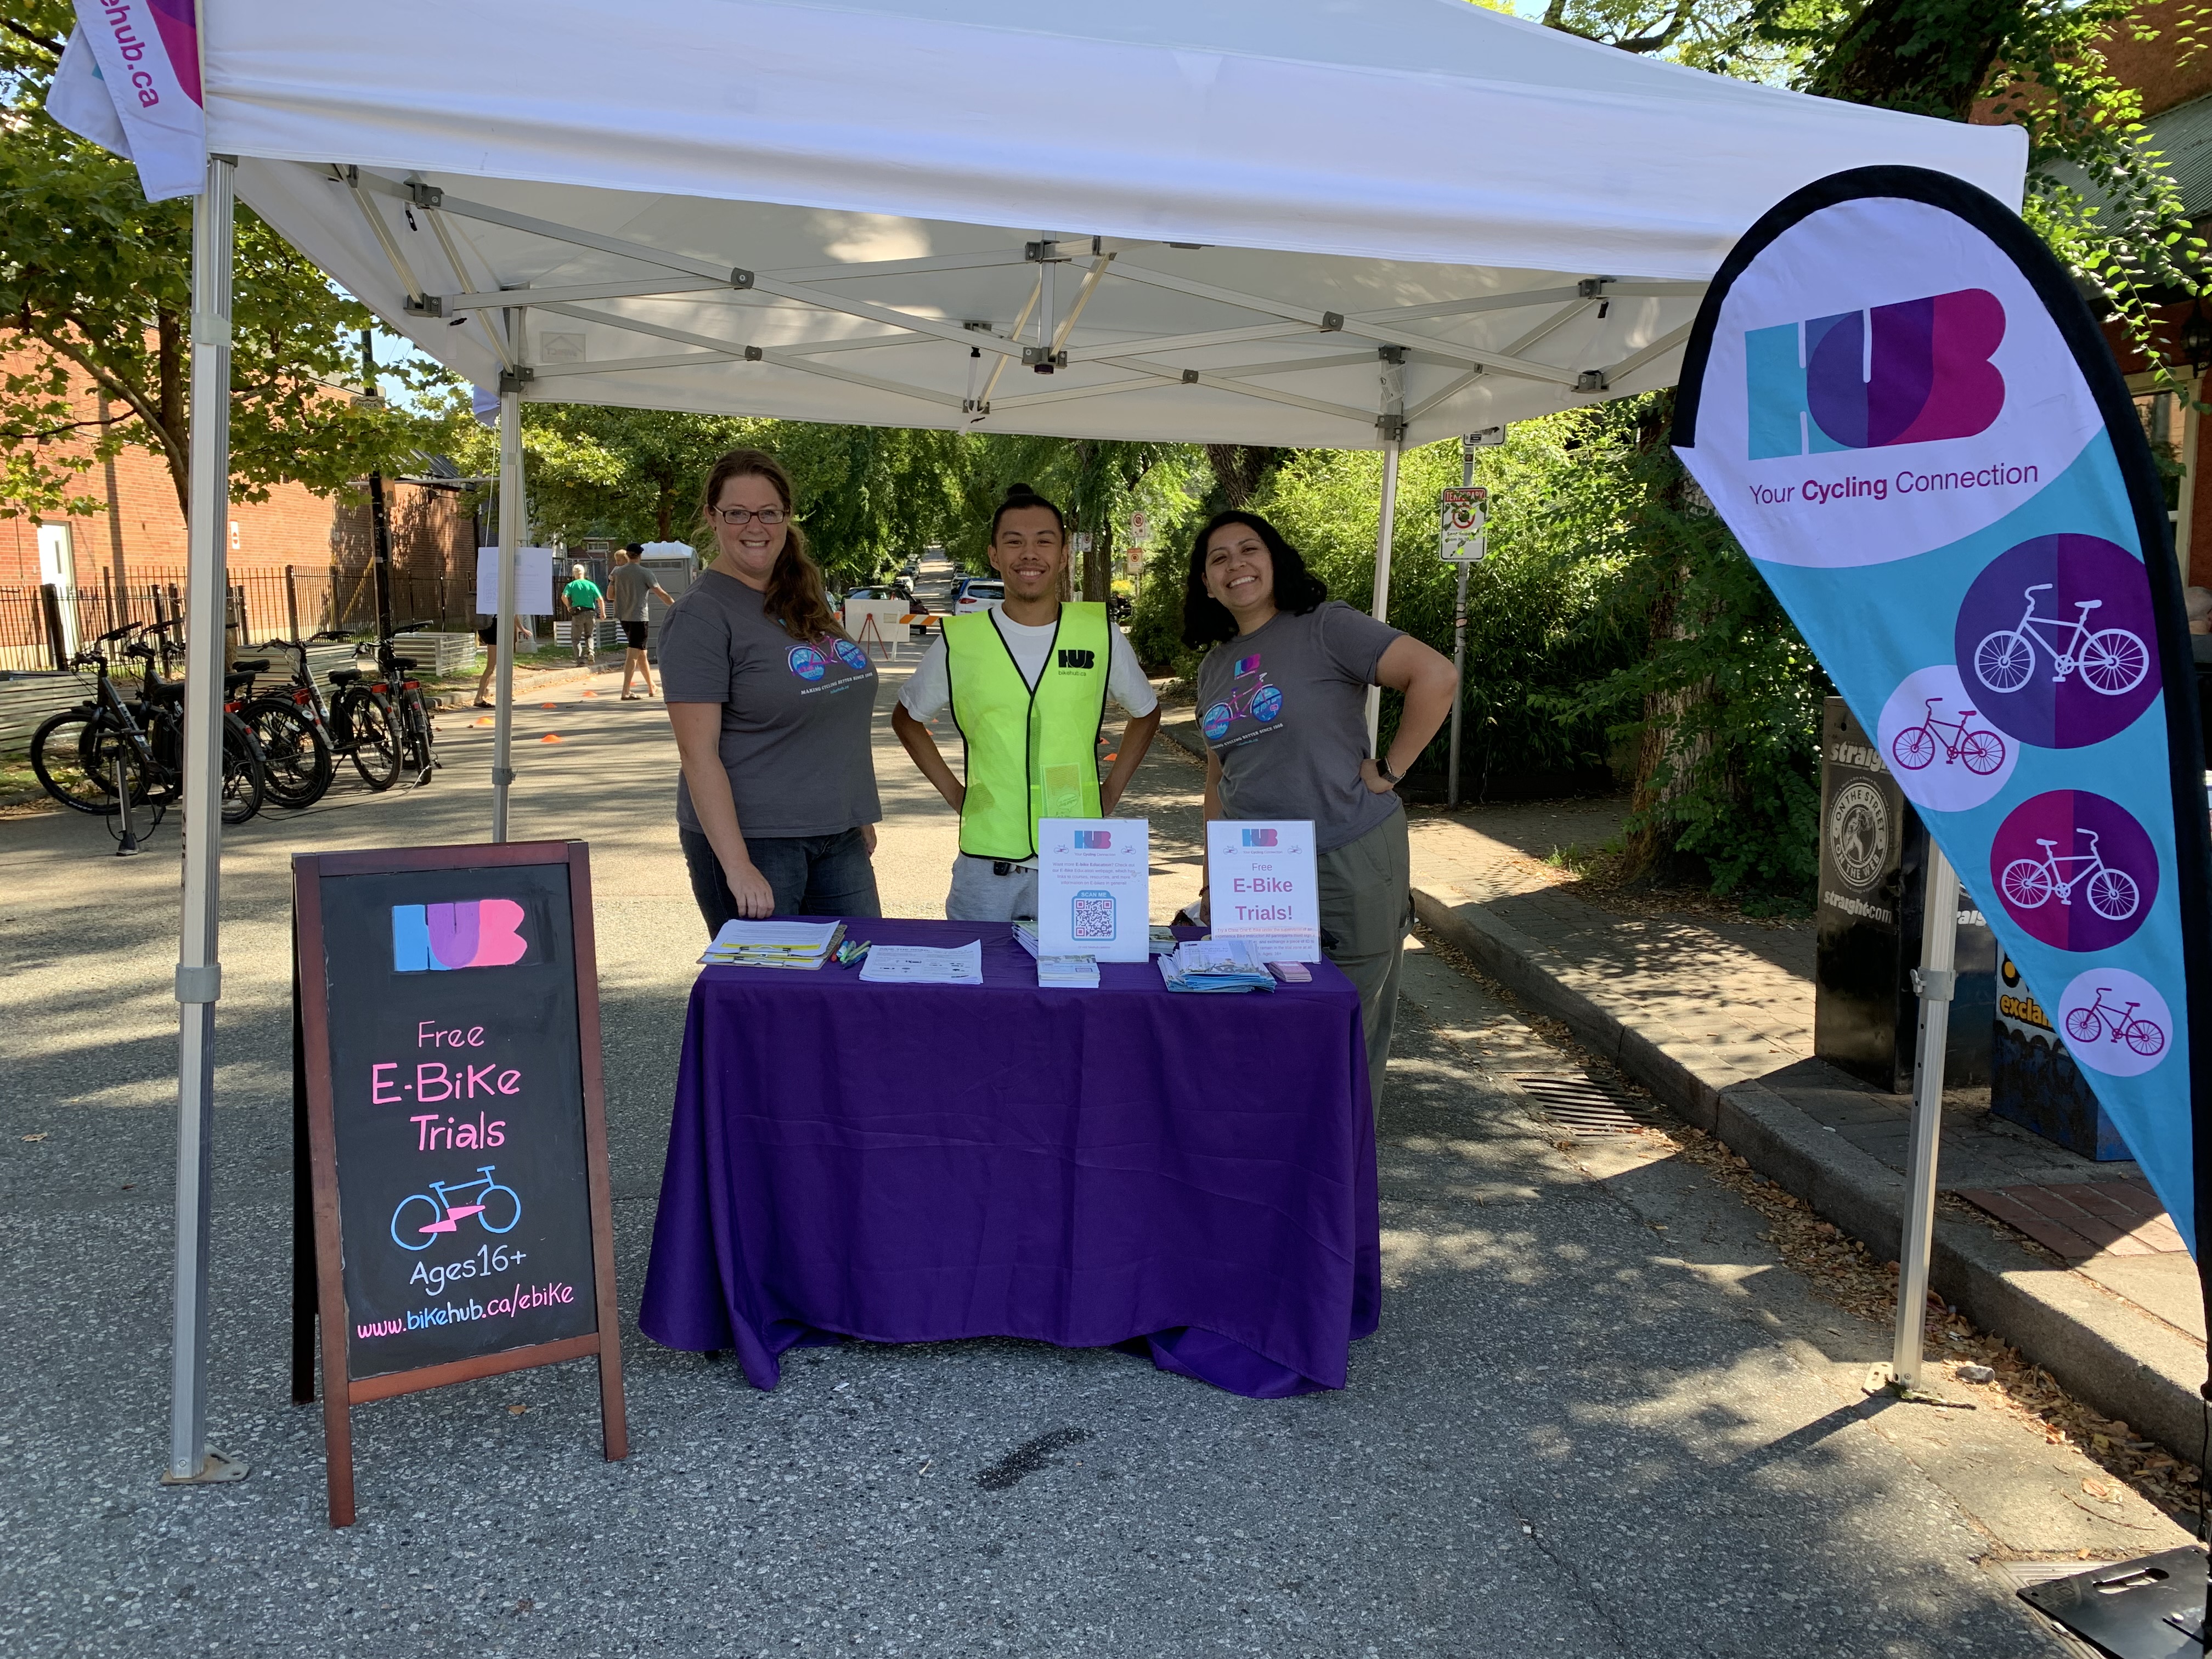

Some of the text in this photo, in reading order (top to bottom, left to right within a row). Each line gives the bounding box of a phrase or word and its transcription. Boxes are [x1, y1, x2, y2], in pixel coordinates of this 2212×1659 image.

[1745, 288, 2006, 461] HUB
[1749, 462, 2039, 505] Your Cycling Connection
[1058, 650, 1095, 669] HUB
[801, 686, 822, 696] MAKING
[821, 680, 838, 691] CYCLING
[837, 676, 853, 685] BETTER
[853, 673, 865, 681] SINCE
[1224, 736, 1243, 746] CYCLING
[1242, 731, 1260, 740] BETTER
[1259, 726, 1273, 734] SINCE
[1830, 741, 1887, 772] straig
[1836, 802, 1846, 821] ON
[1845, 789, 1861, 805] THE
[1864, 792, 1885, 832] STREET
[1074, 830, 1111, 849] HUB
[1242, 828, 1278, 847] HUB
[1252, 863, 1272, 871] Free
[1835, 843, 1880, 879] ON THE WEB
[1233, 877, 1293, 893] E-Bike
[1234, 905, 1292, 921] Trials!
[392, 899, 528, 972] HUB
[418, 1020, 484, 1048] Free
[410, 1110, 506, 1151] Trials
